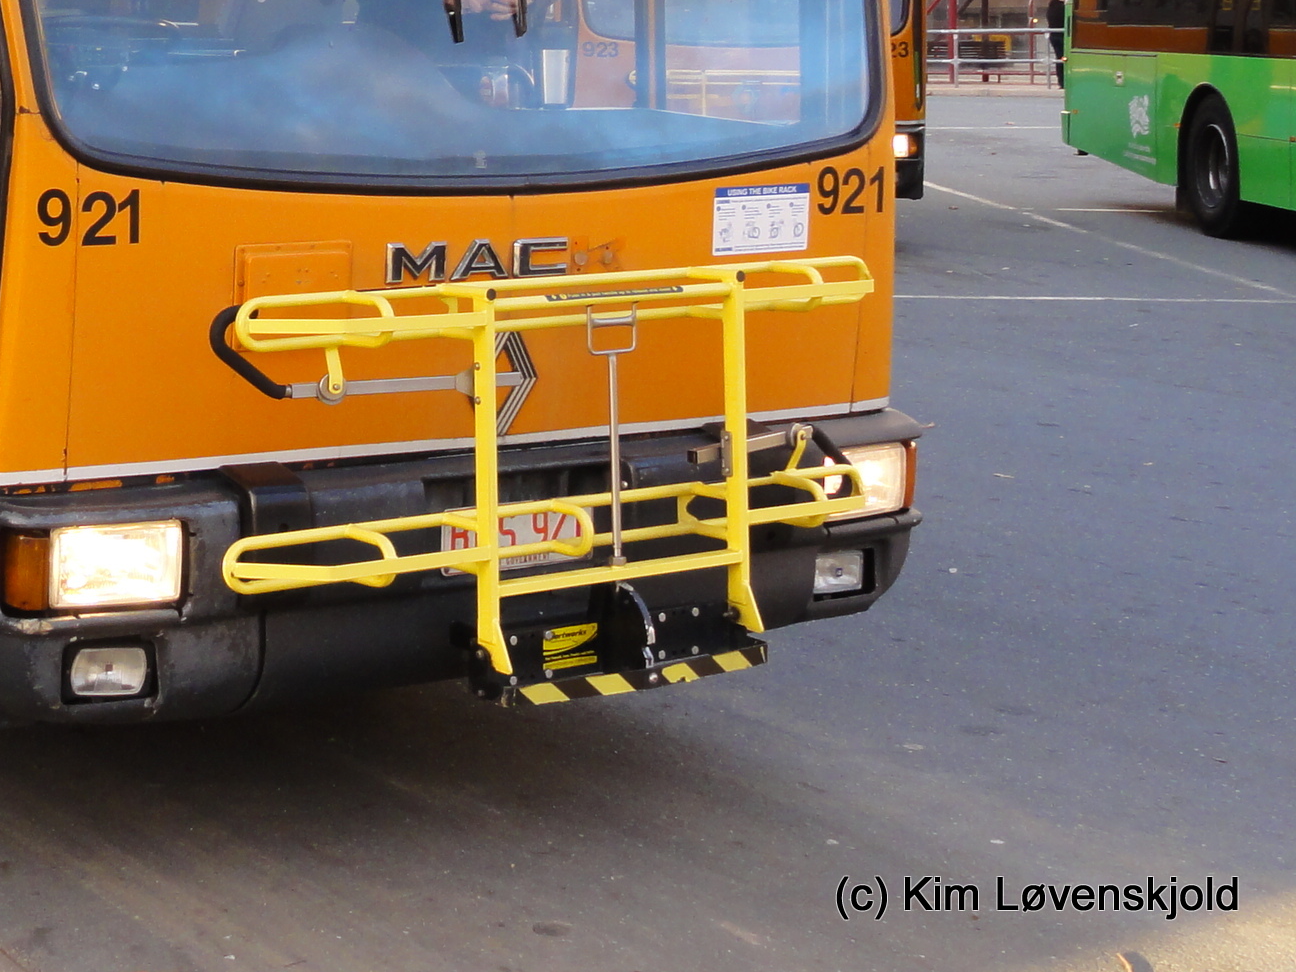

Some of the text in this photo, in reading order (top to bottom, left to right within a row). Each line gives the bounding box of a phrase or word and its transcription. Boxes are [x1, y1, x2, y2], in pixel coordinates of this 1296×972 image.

[582, 41, 619, 58] 923
[727, 185, 797, 196] USING THE BIKE RACK
[816, 165, 885, 216] 921
[37, 188, 141, 247] 921
